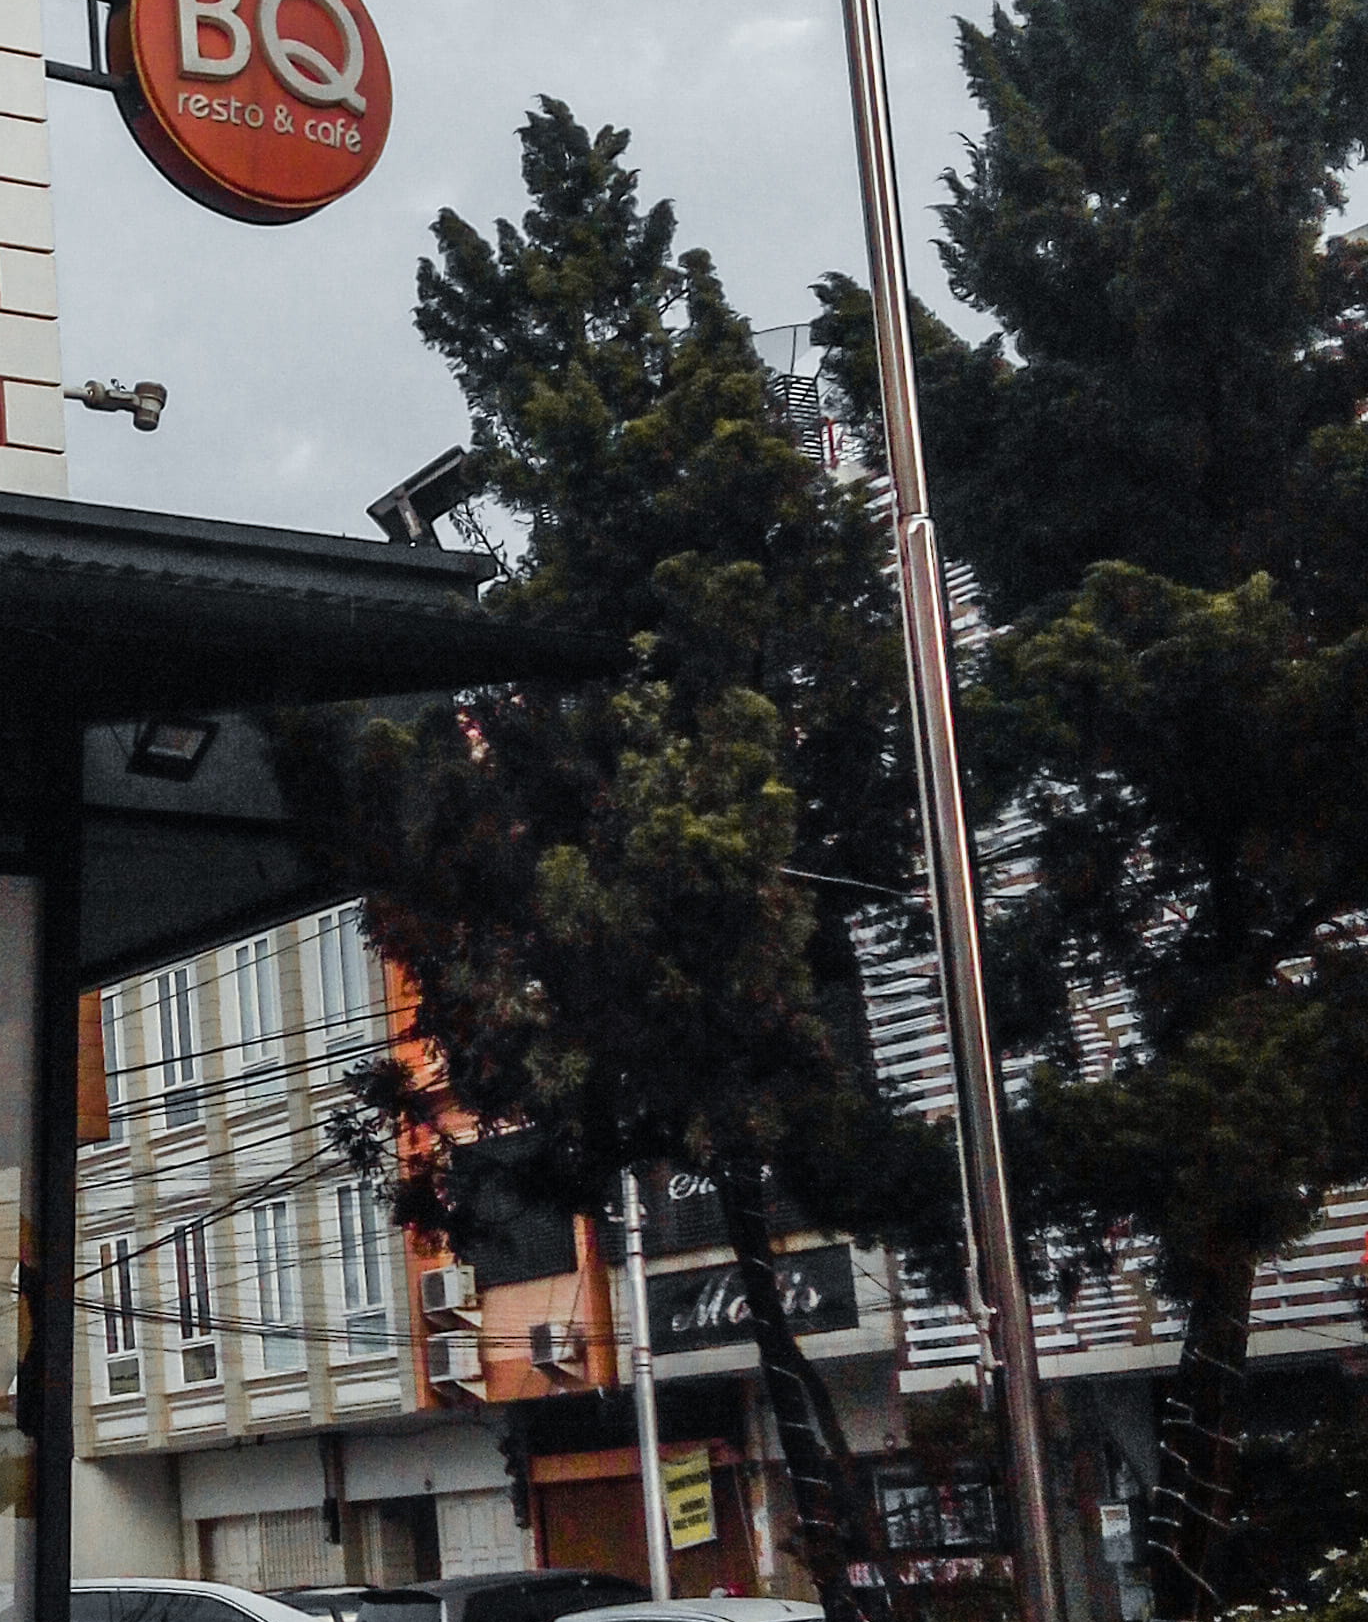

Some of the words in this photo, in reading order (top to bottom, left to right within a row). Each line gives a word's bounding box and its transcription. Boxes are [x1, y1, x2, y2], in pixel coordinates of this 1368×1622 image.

[177, 91, 264, 128] resto
[273, 104, 295, 134] &
[304, 117, 362, 154] café
